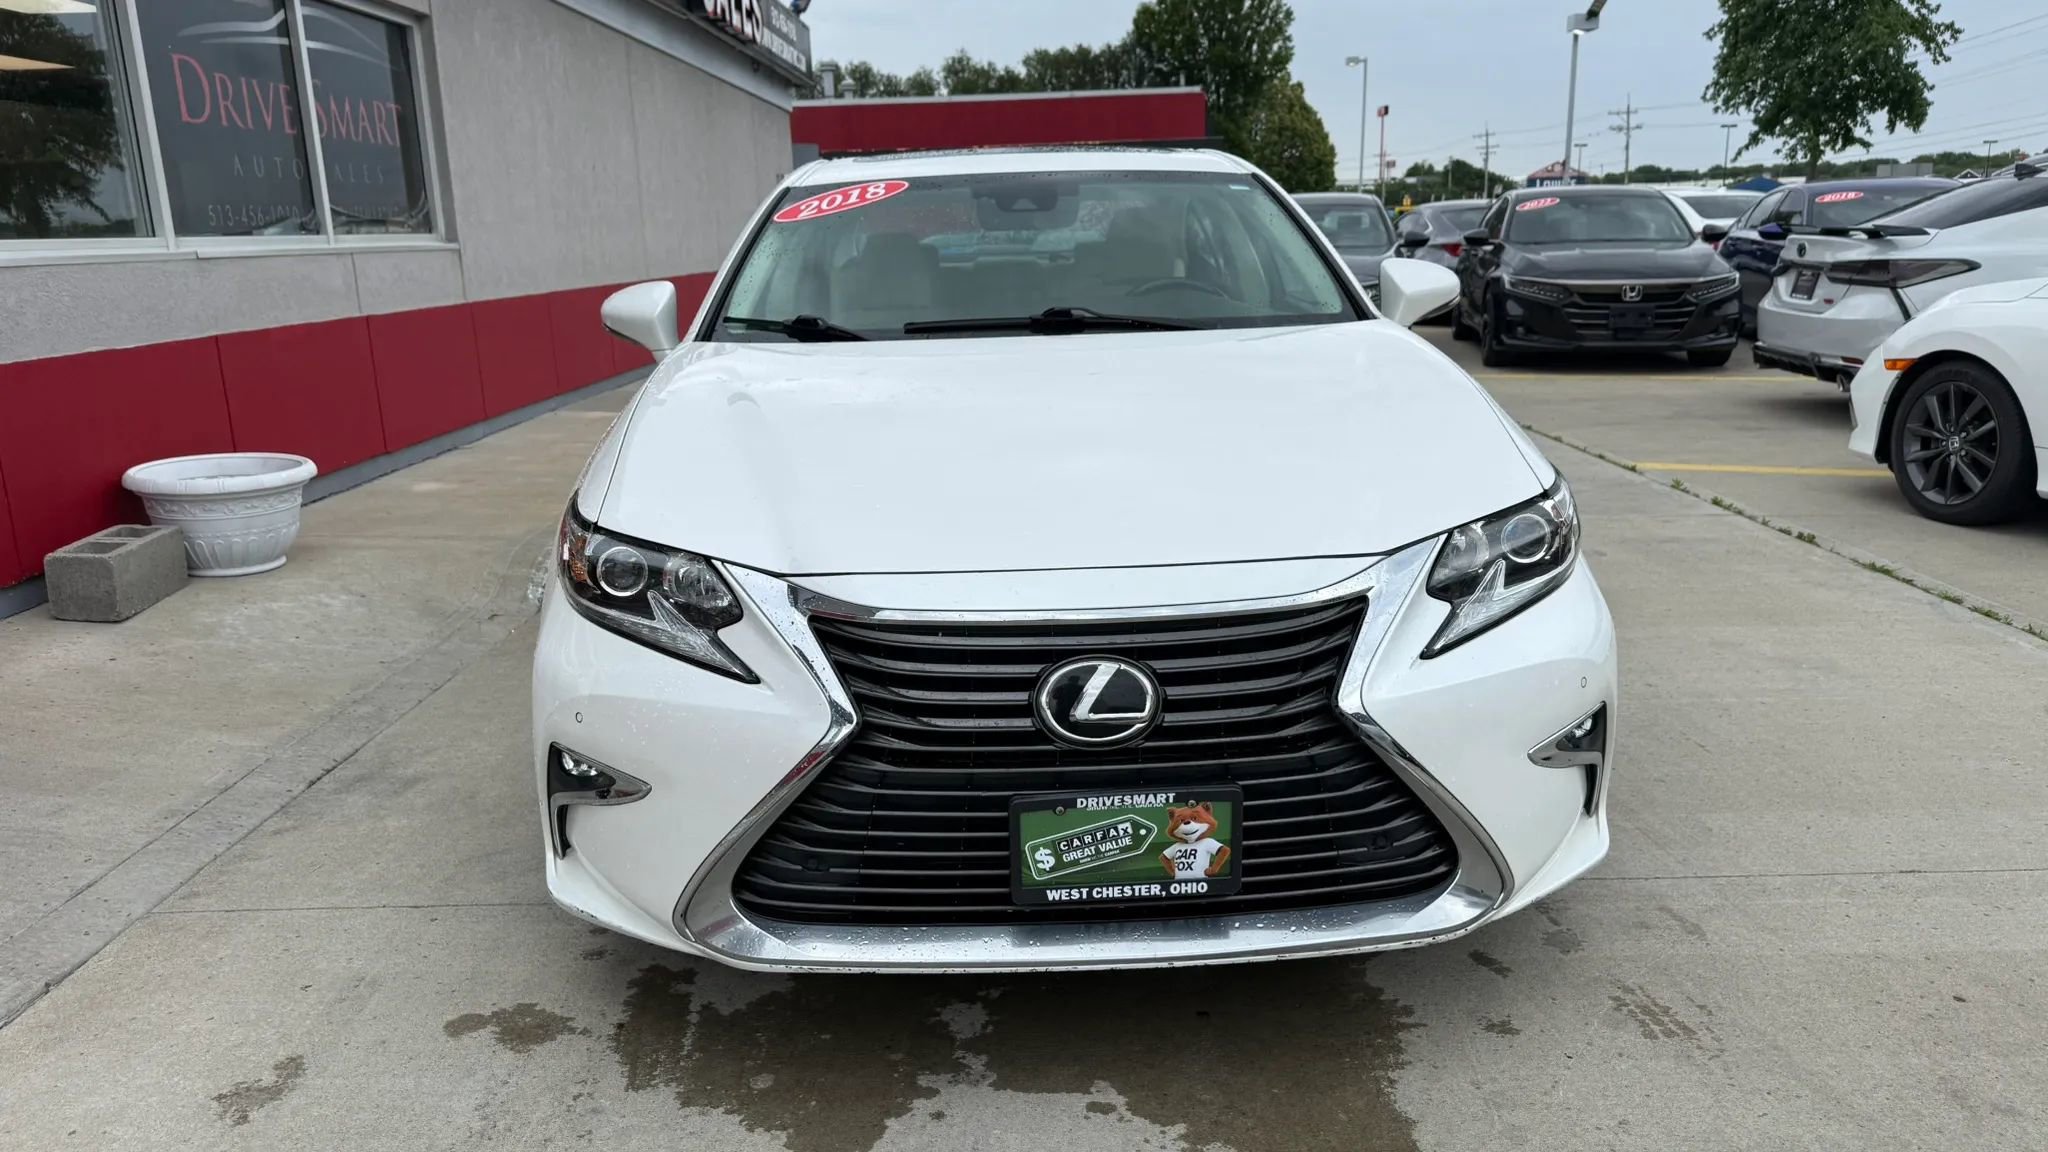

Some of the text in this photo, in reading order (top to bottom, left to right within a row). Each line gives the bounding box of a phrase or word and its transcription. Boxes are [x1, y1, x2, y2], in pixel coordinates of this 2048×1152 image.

[171, 53, 297, 135] DRIVE
[233, 153, 386, 185] AUTO ALES
[796, 183, 886, 219] 2018
[1076, 793, 1176, 809] DRIVESMART
[1058, 824, 1132, 851] CARFAX
[1062, 846, 1097, 863] GREAT
[1098, 836, 1133, 852] VALUE
[1034, 846, 1056, 871] $
[1175, 848, 1198, 861] CAR
[1046, 881, 1208, 901] WEST CHESTER, OHIO
